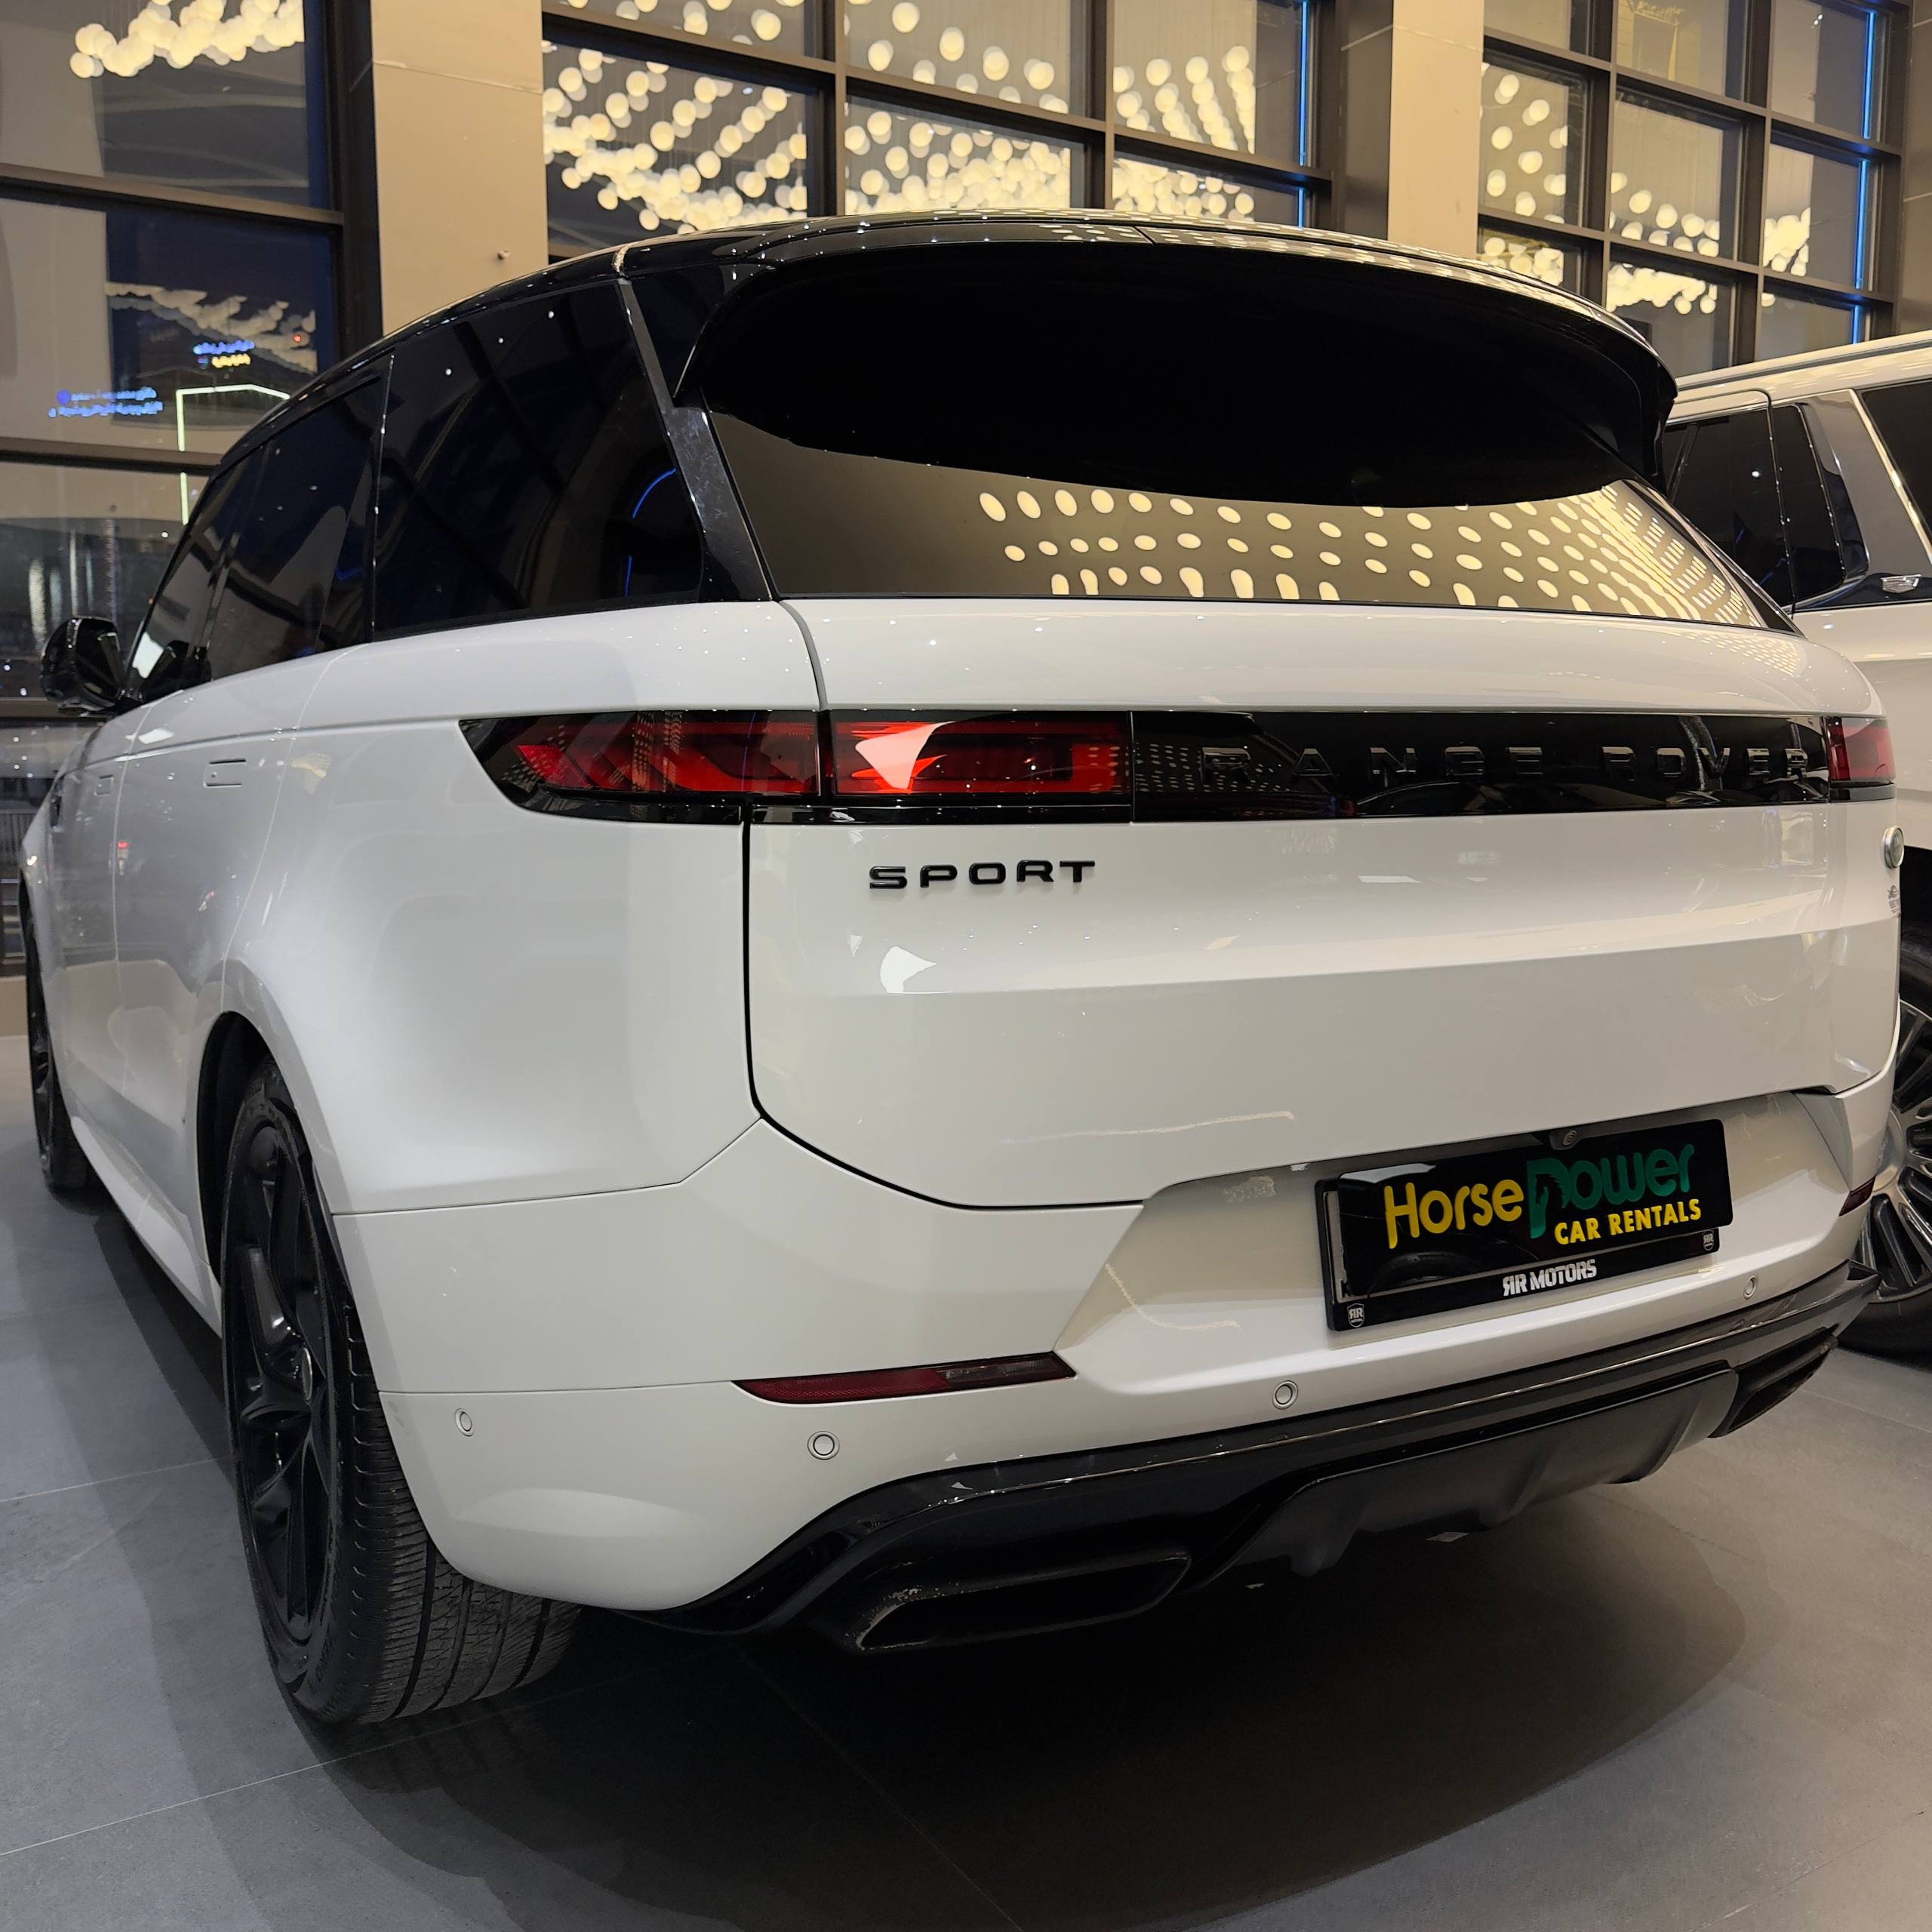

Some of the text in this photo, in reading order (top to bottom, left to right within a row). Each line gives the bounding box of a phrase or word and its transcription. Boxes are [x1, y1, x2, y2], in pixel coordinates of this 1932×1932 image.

[1202, 746, 1809, 782] RANGE ROVER
[869, 860, 1096, 889] SPORT
[1554, 1198, 1701, 1245] CAR RENTALS
[1529, 1258, 1598, 1291] MOTORS
